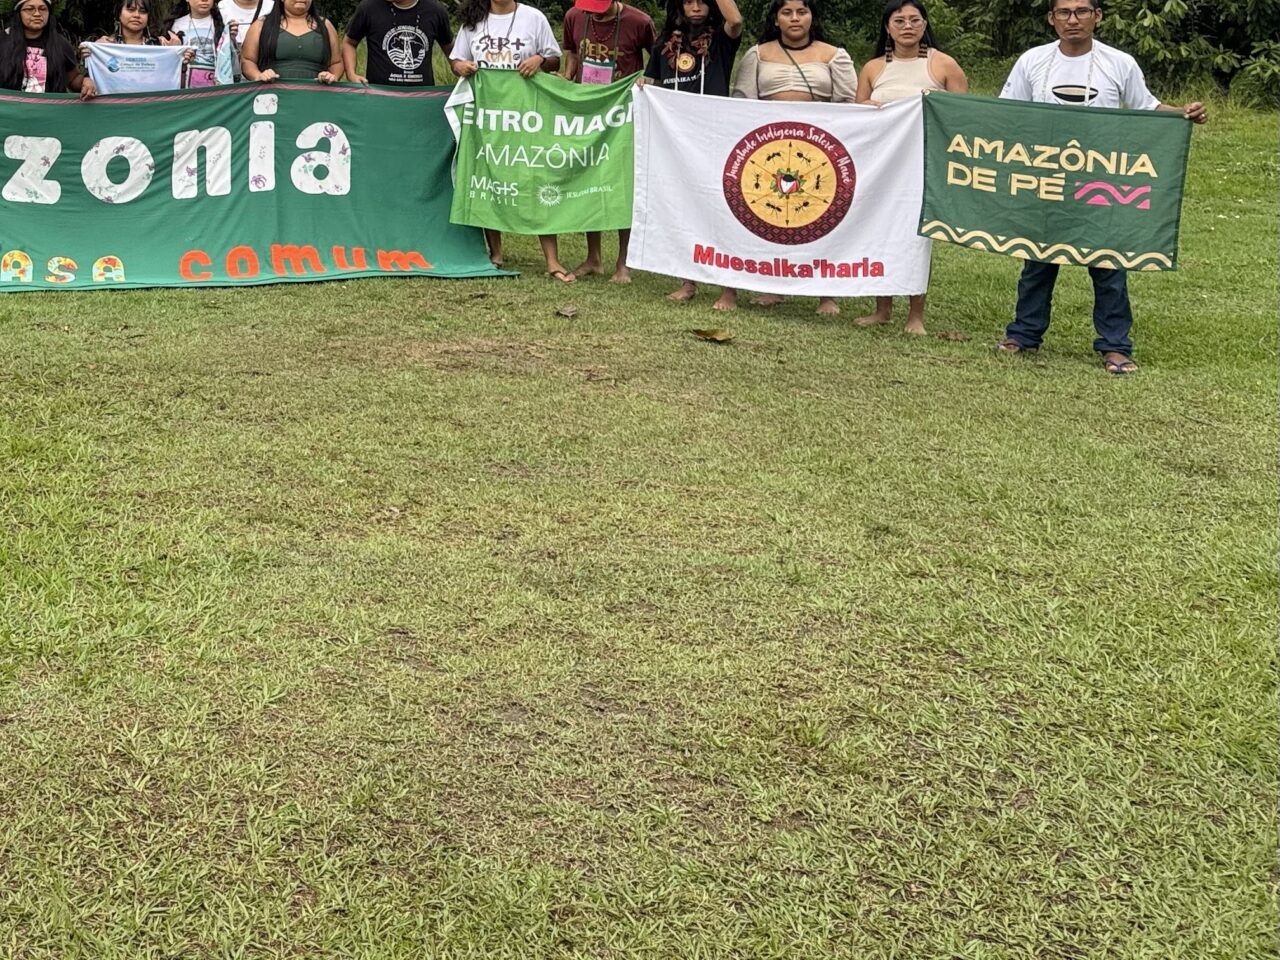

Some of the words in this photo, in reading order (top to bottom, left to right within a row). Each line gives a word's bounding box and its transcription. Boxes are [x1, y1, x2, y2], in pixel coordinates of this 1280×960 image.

[476, 143, 609, 169] AMAZÔNIA
[725, 140, 757, 179] Juventude
[947, 133, 1159, 178] AMAZÔNIA
[470, 190, 518, 207] BRASIL
[947, 160, 997, 192] DE
[1009, 172, 1066, 201] PÉ
